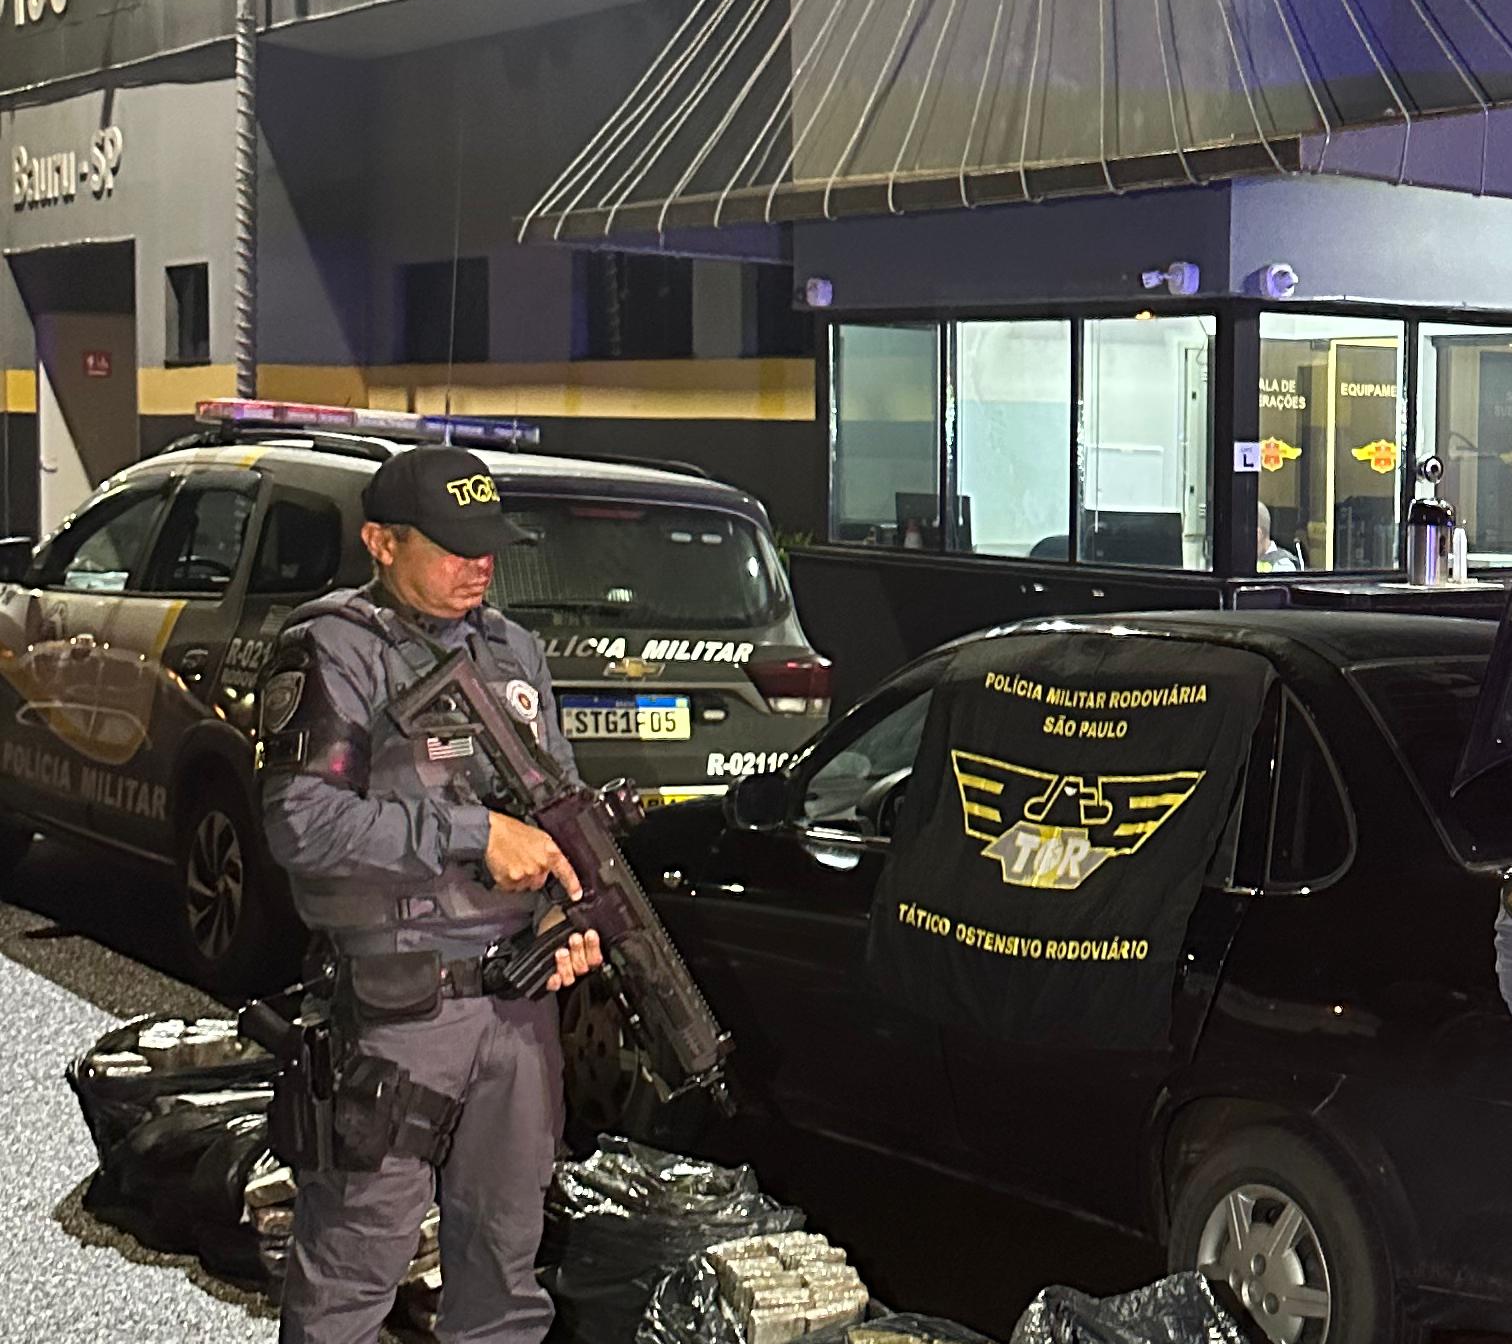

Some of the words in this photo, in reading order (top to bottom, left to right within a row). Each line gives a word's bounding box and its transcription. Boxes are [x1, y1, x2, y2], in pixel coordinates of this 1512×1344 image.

[1259, 378, 1279, 393] ALA
[1281, 379, 1296, 393] DE
[1340, 382, 1397, 398] EQUIPAME
[1259, 394, 1306, 411] ERAÇÕES
[544, 635, 626, 659] LÍCIA
[642, 639, 754, 663] MILITAR
[985, 672, 1043, 701] POLÍCIA
[1046, 687, 1107, 709] MILITAR
[1109, 684, 1208, 709] RODOVIÁRIA
[575, 711, 676, 735] STG1F05
[1043, 715, 1077, 738] SÃO
[1079, 719, 1128, 739] PAULO
[81, 766, 168, 821] MILITAR
[898, 901, 951, 937] TÁTICO
[955, 921, 1042, 959] OSTENSIVO
[1045, 935, 1149, 961] RODOVIÁRIO
